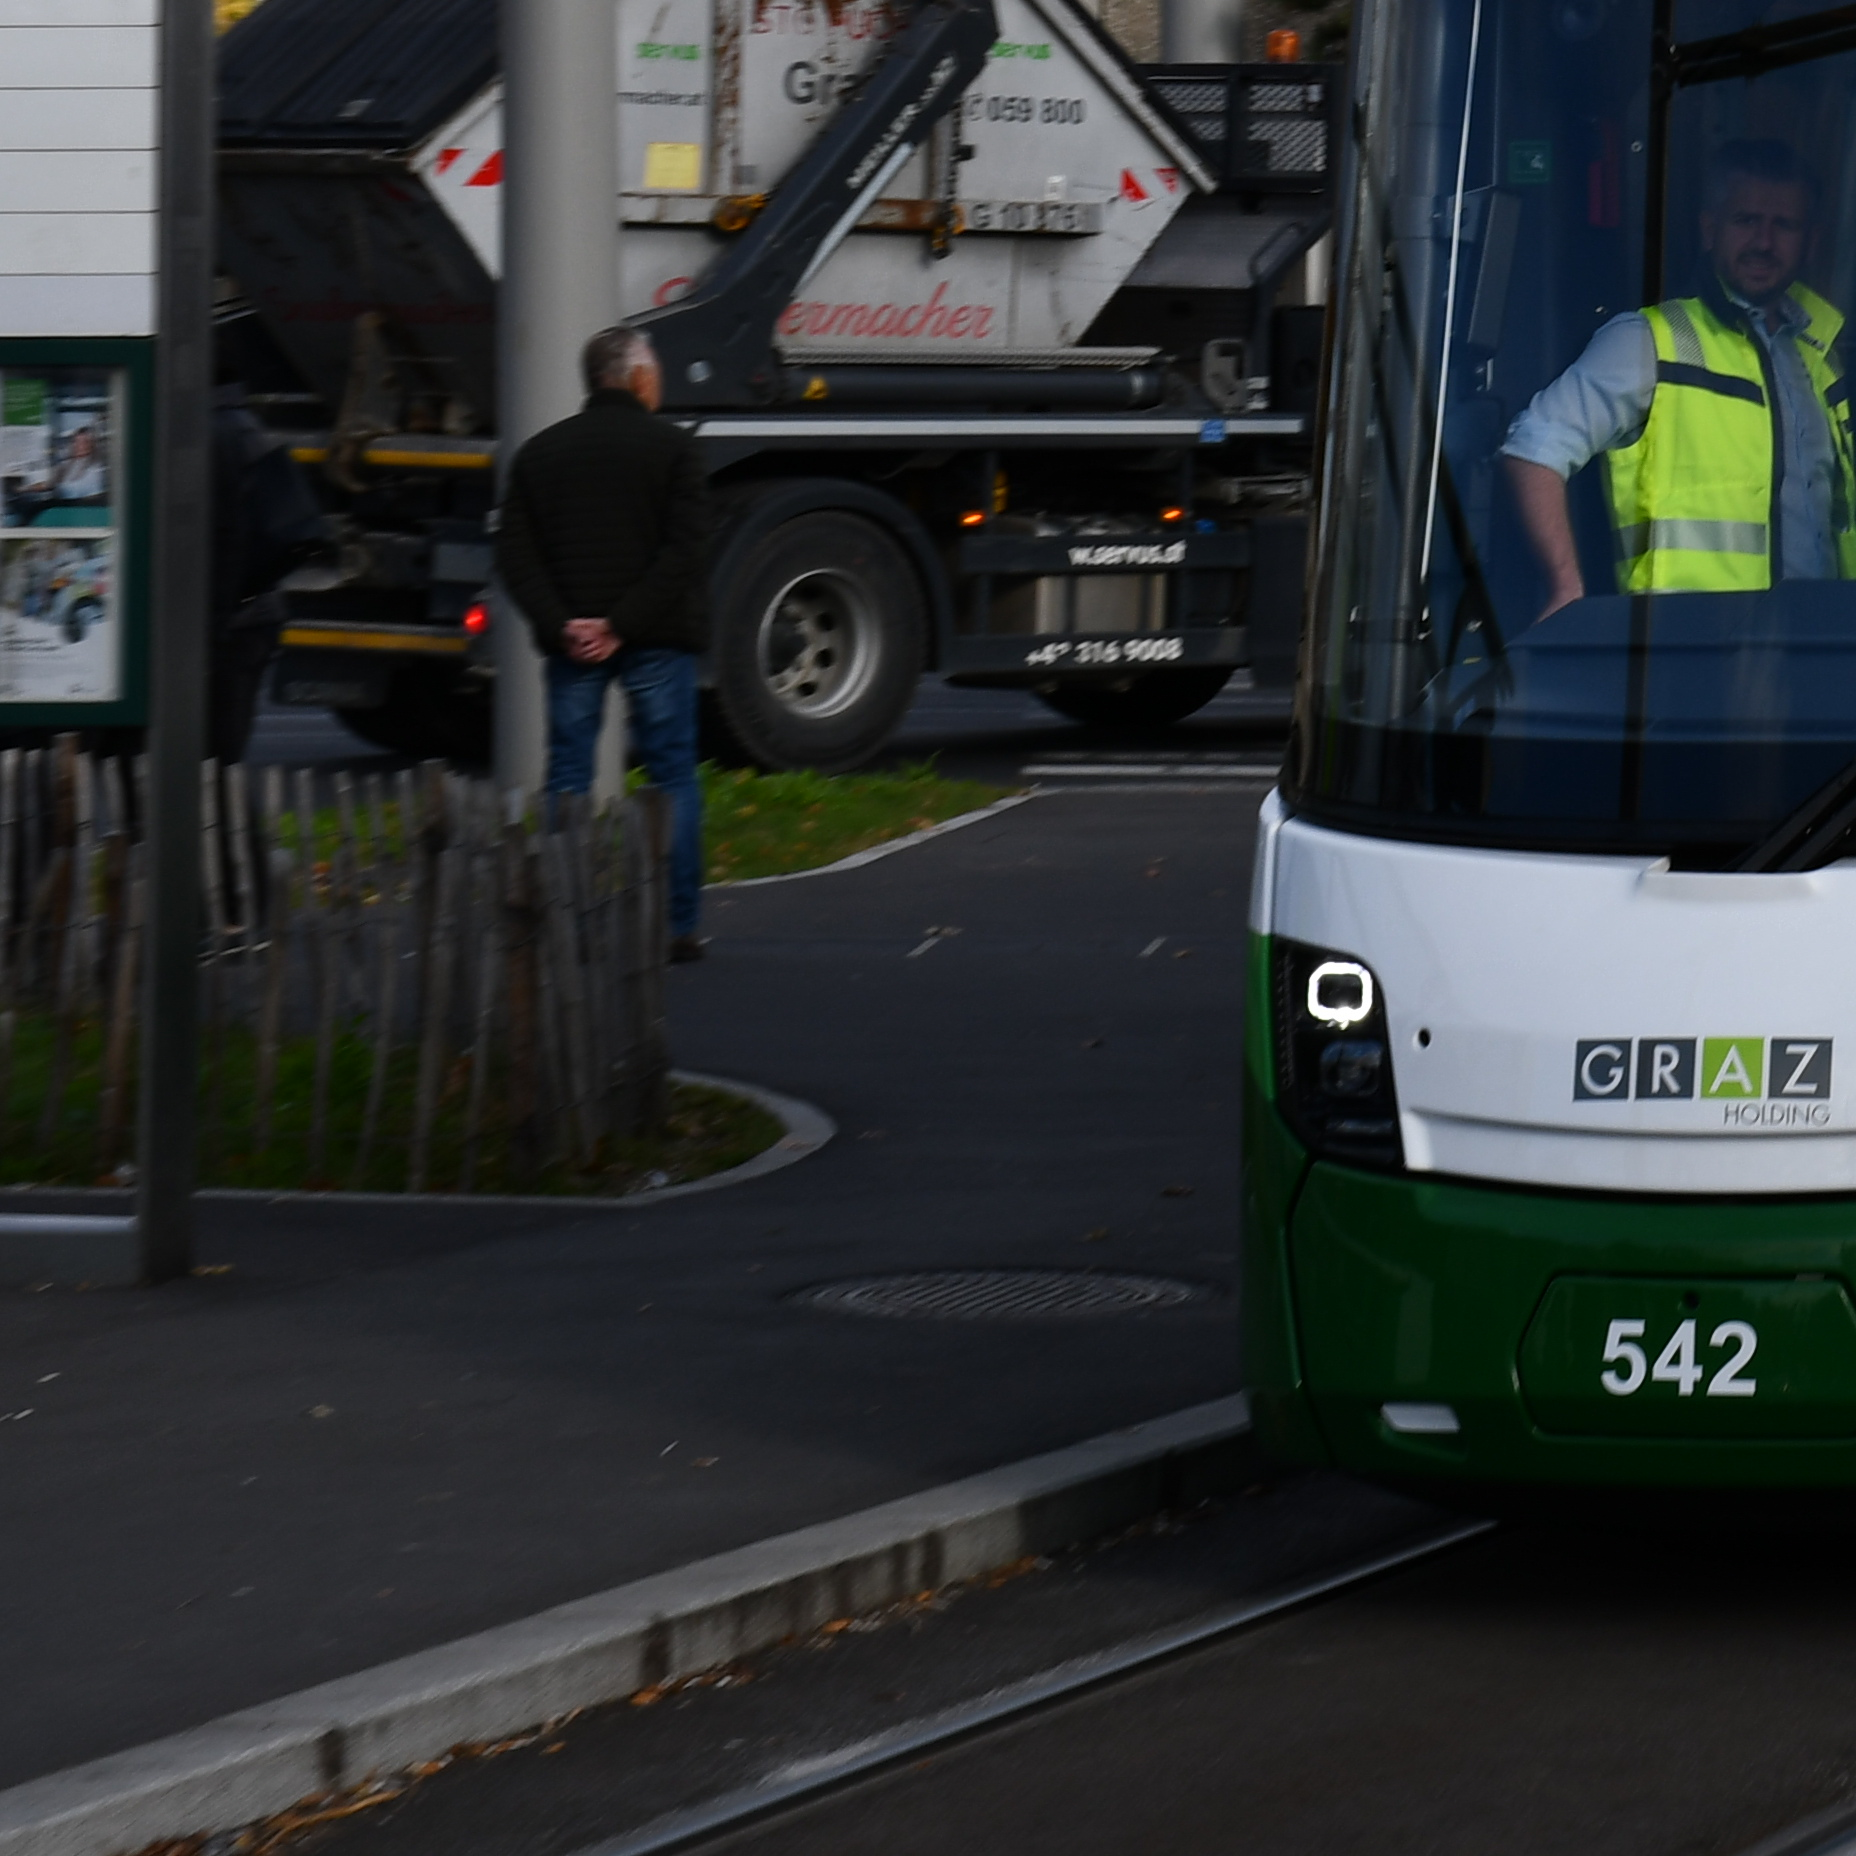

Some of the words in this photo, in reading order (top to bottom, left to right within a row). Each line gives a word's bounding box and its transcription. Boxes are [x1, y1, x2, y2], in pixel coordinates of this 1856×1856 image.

[1041, 97, 1085, 125] 800
[1577, 1041, 1826, 1098] GRAZ
[1723, 1102, 1832, 1127] HOLDING
[1600, 1317, 1758, 1398] 542
